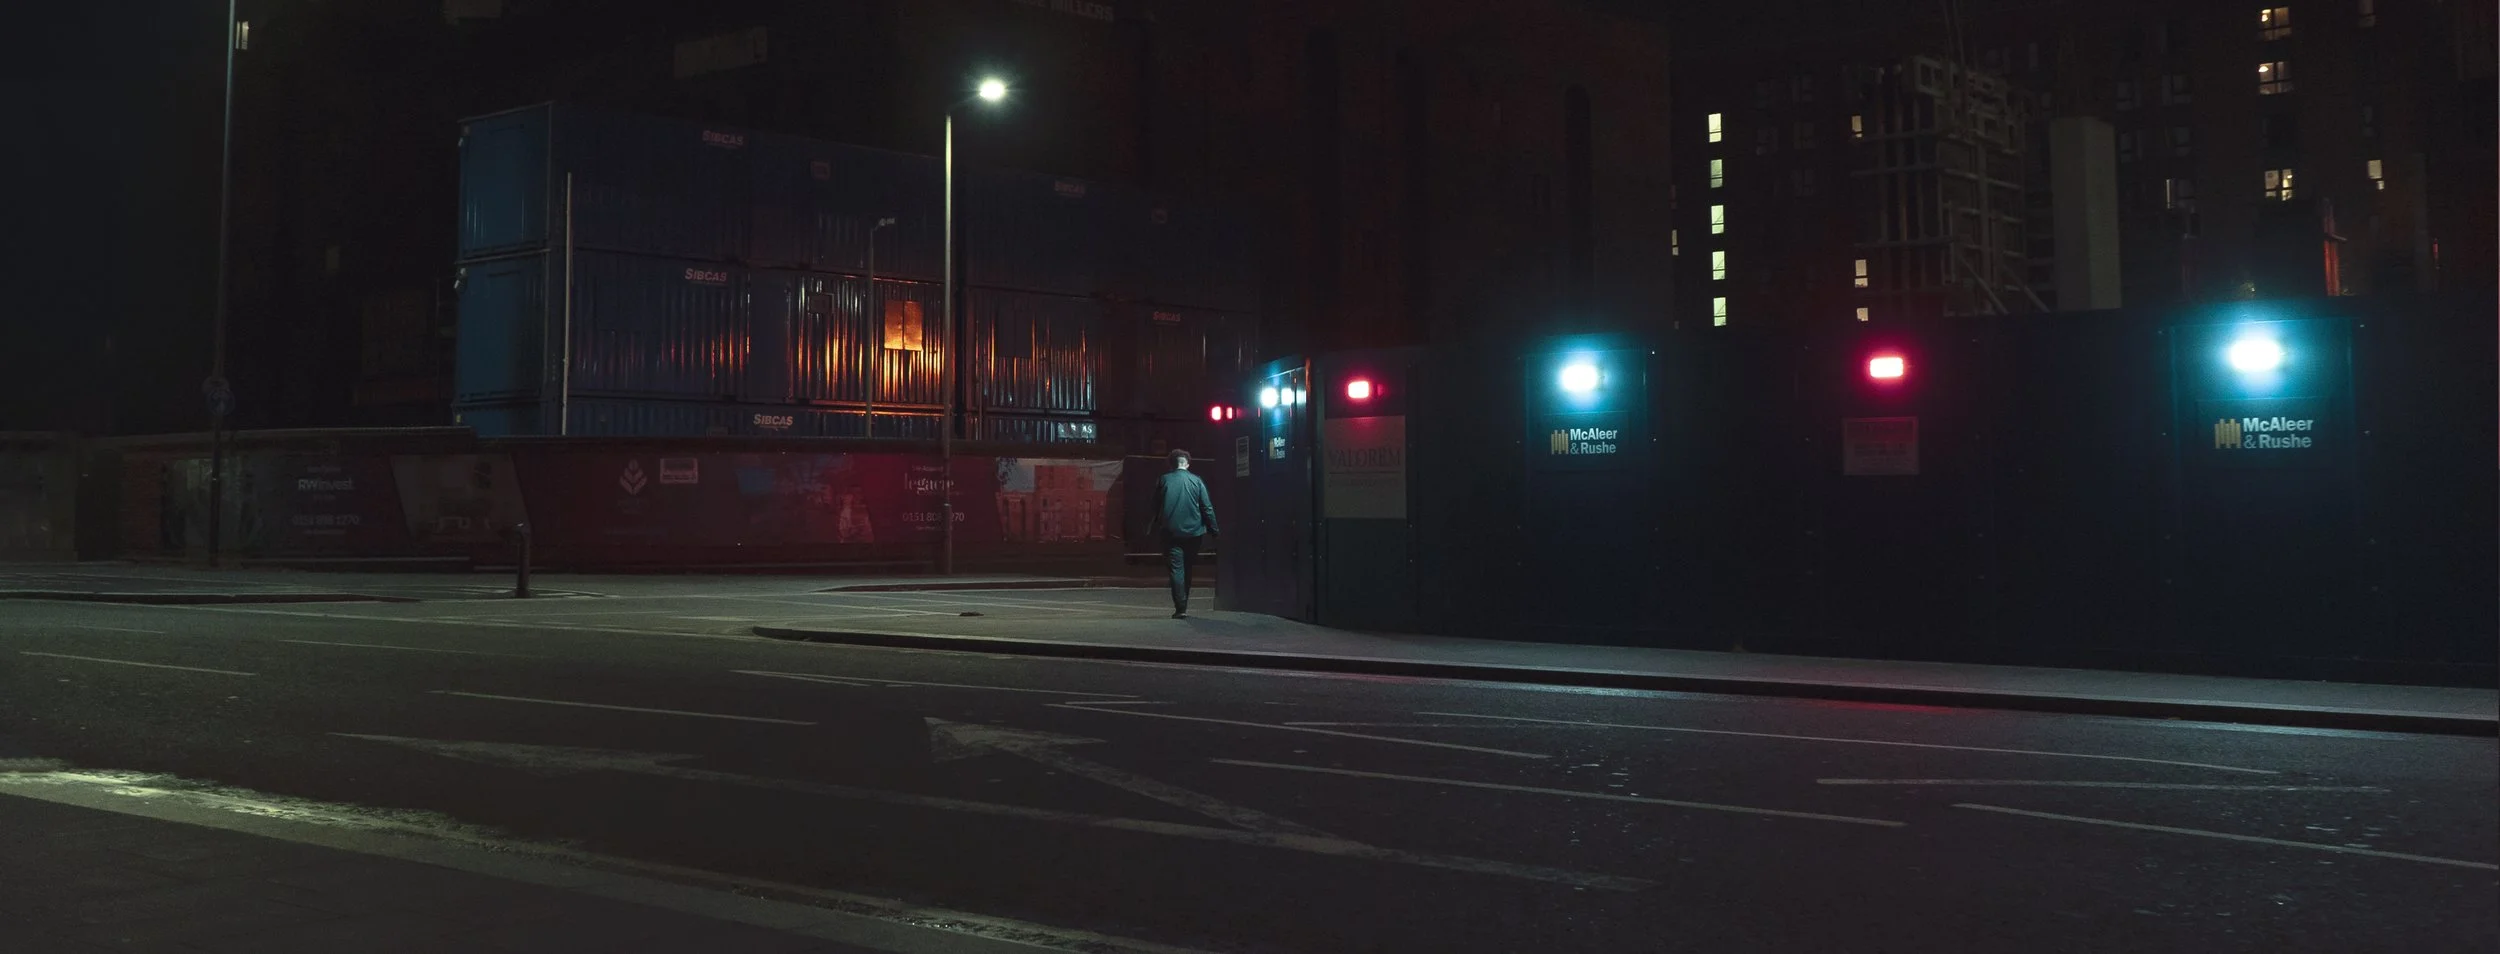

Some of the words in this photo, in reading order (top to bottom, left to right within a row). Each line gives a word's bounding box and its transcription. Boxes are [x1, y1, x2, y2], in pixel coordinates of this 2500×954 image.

[684, 267, 728, 282] SIBCAS
[753, 413, 794, 426] SIBCAS
[2242, 416, 2315, 432] McAleer
[1569, 427, 1618, 441] McAleer
[2243, 434, 2257, 449] &
[2258, 433, 2313, 448] Rushe
[1569, 442, 1579, 455] &
[1580, 441, 1617, 455] Rushe
